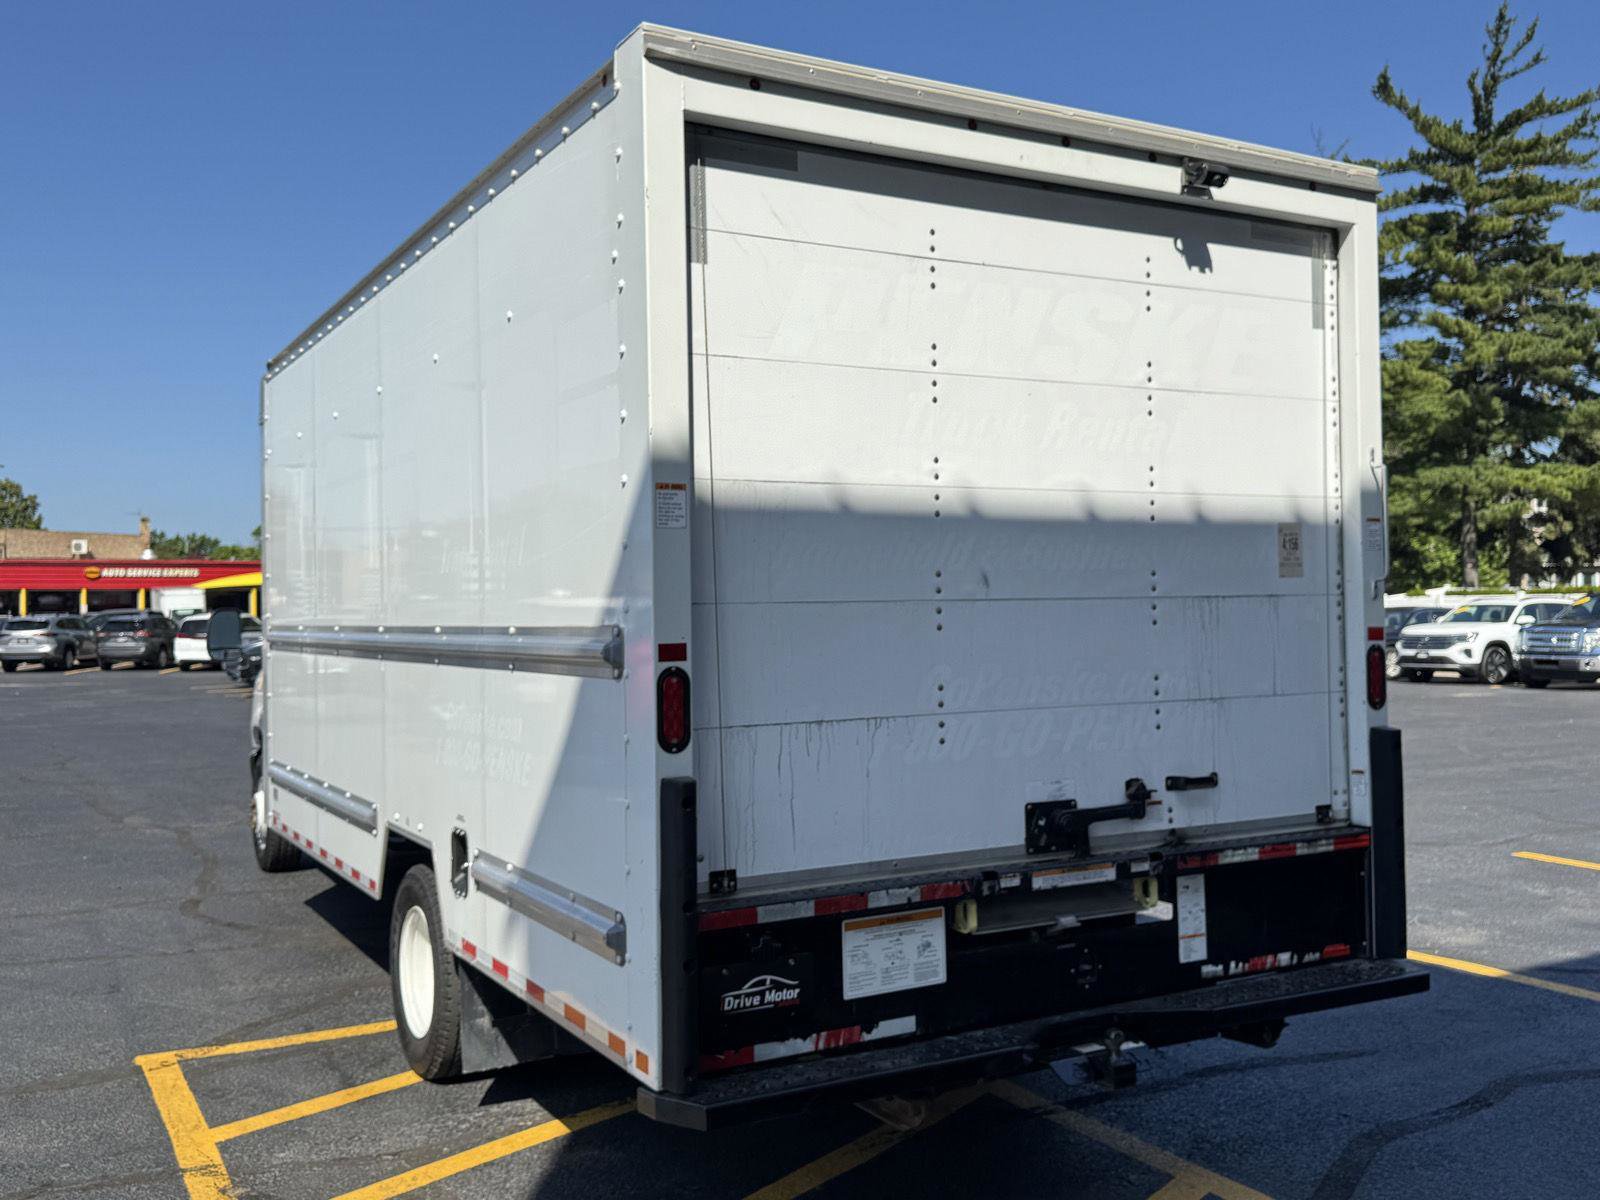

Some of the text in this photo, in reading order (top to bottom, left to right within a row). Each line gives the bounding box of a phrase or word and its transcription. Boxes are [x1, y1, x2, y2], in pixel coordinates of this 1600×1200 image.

[102, 567, 126, 578] AUTO
[126, 567, 162, 578] SERVICE
[723, 994, 761, 1011] Drive
[764, 987, 801, 1004] Motor
